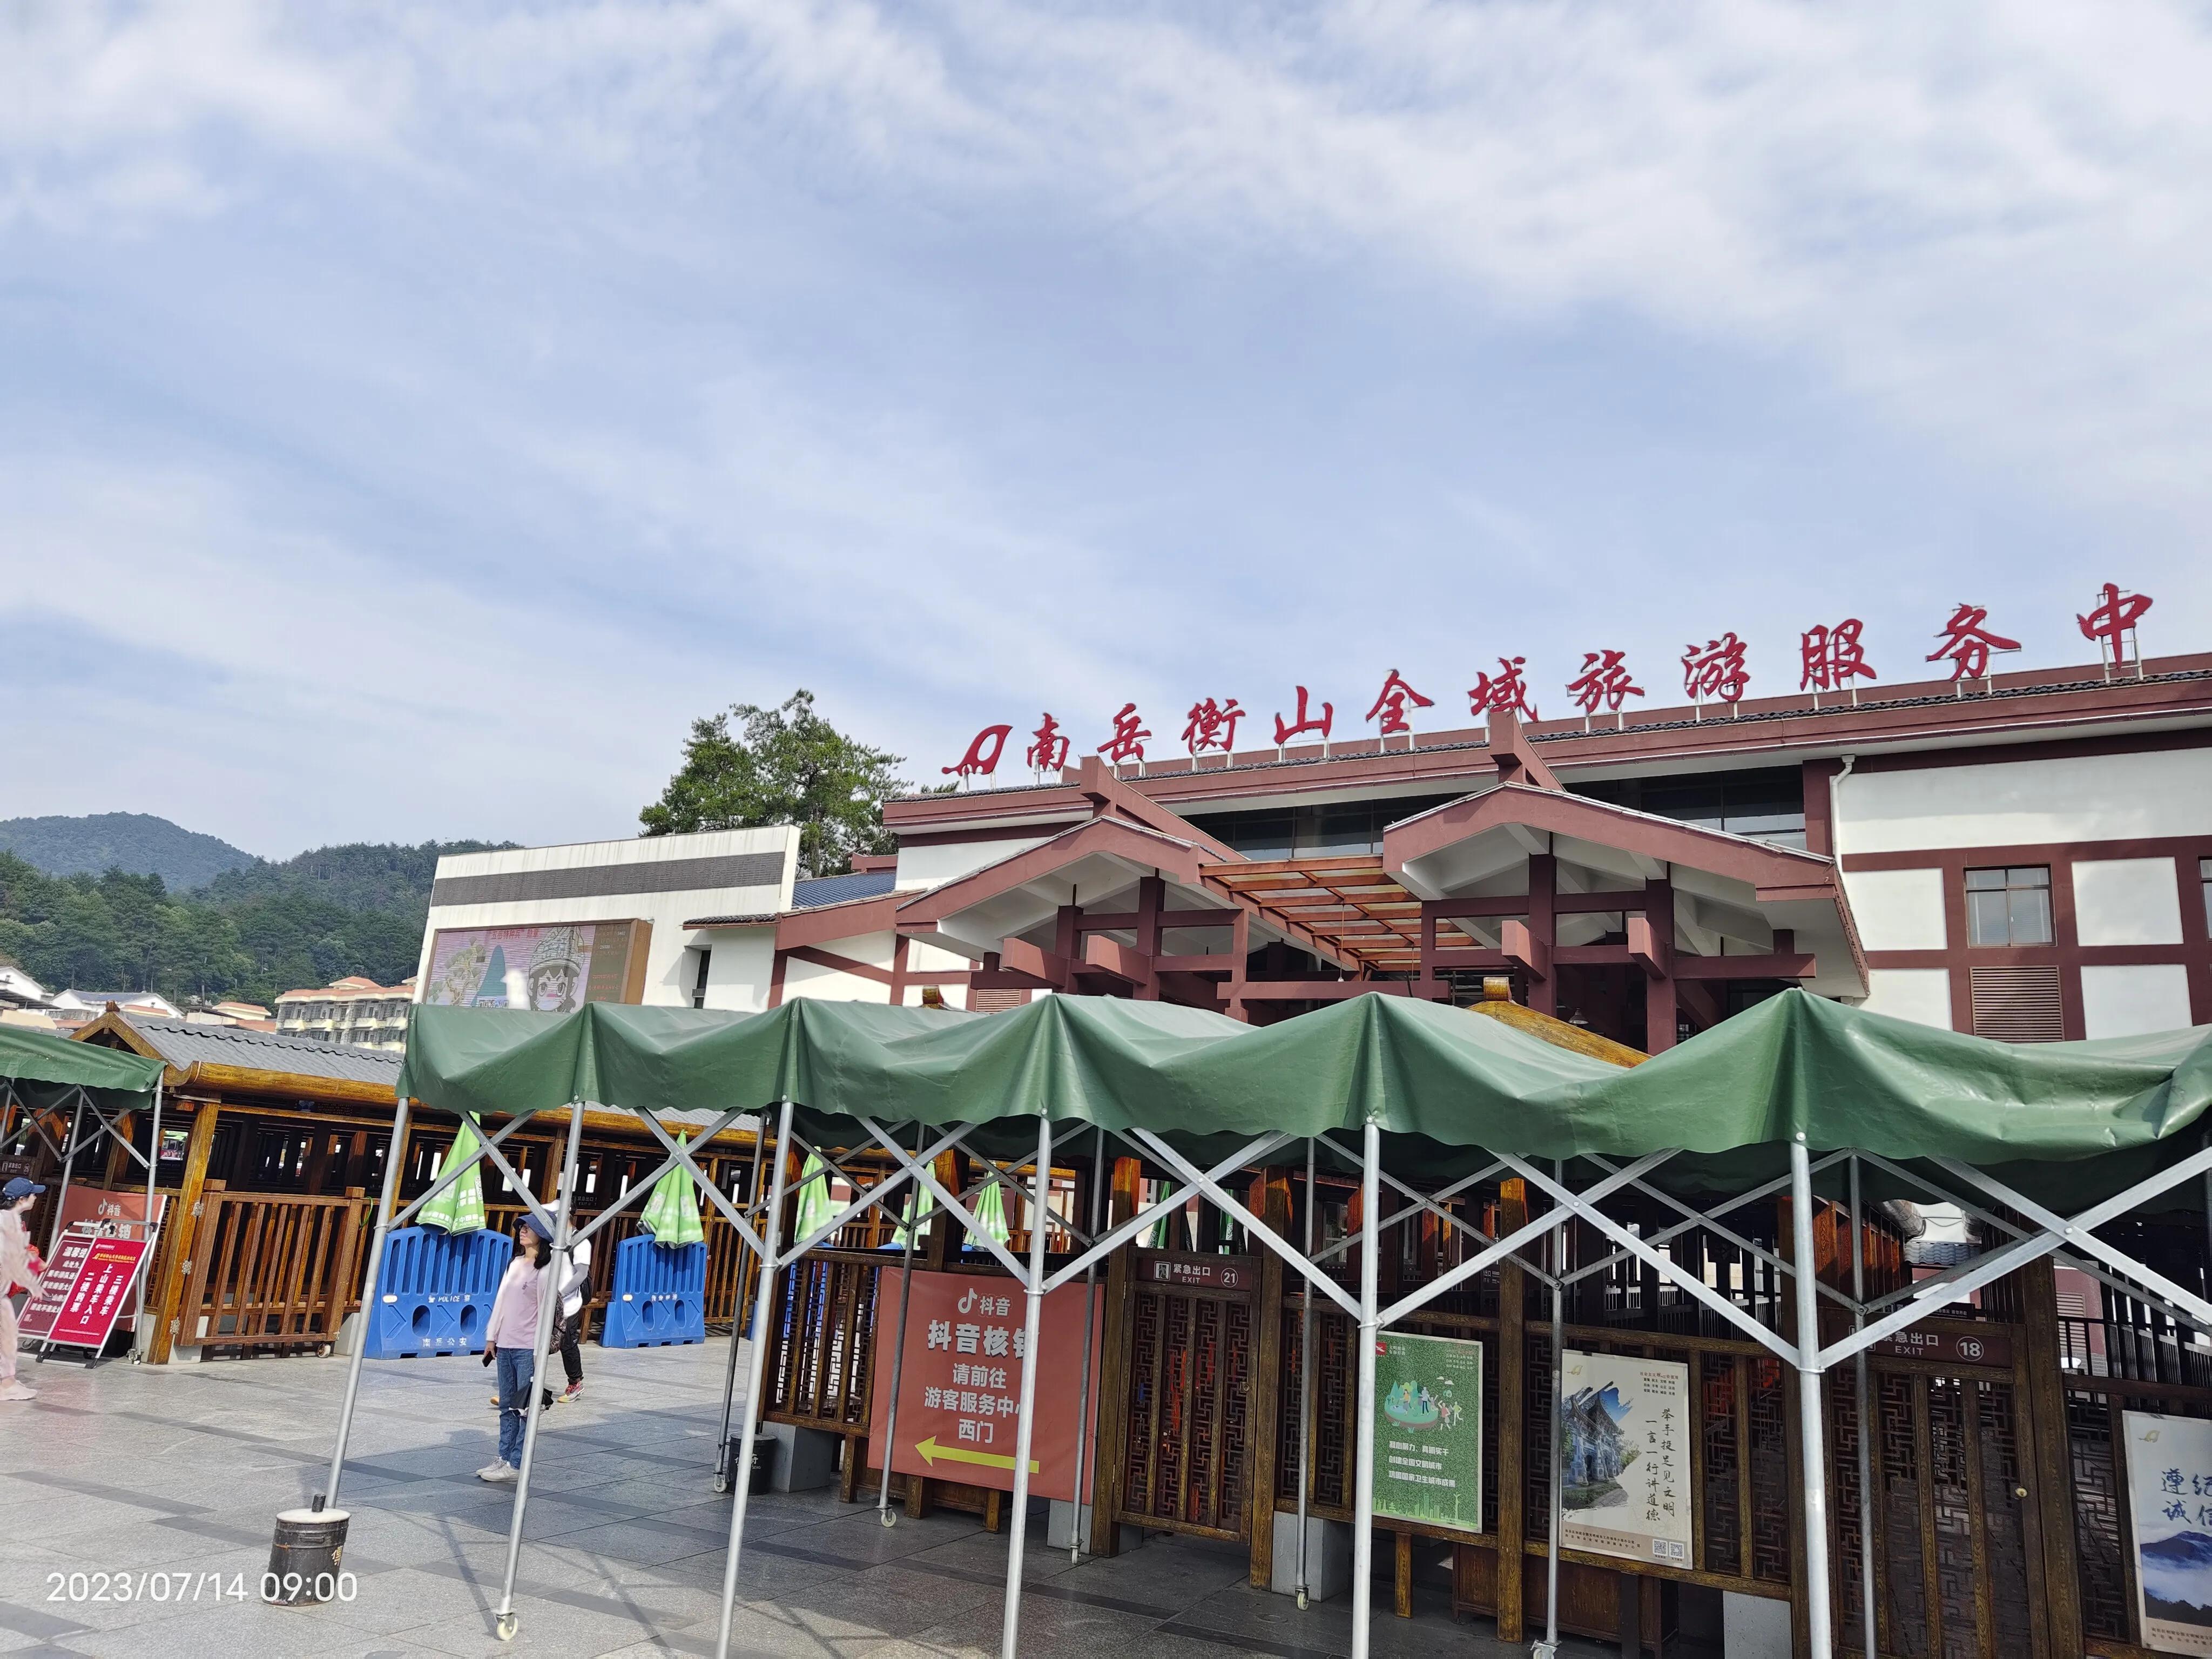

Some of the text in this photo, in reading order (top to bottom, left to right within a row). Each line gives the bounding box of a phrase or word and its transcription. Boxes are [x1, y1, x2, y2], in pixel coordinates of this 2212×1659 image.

[106, 1203, 122, 1217] 抖音
[1173, 1263, 1211, 1277] 紧急出口
[1223, 1272, 1236, 1284] 21
[79, 1263, 113, 1325] 上山乘车入口
[99, 1274, 124, 1316] 三楼乘车
[979, 1295, 1011, 1317] 抖音
[422, 1337, 467, 1347] 南岳公安
[1895, 1345, 1924, 1356] EXIT
[1959, 1341, 1981, 1357] 18
[953, 1362, 1007, 1390] 请前往
[923, 1386, 1021, 1418] 游客服务中
[958, 1418, 994, 1444] 西门
[1388, 1455, 1442, 1471] 创建全国文明城市
[1645, 1419, 1661, 1522] 一言一行讲道德
[1661, 1407, 1676, 1518] 举手投足见文明
[1388, 1470, 1456, 1488] 巩固国家卫生城市成果
